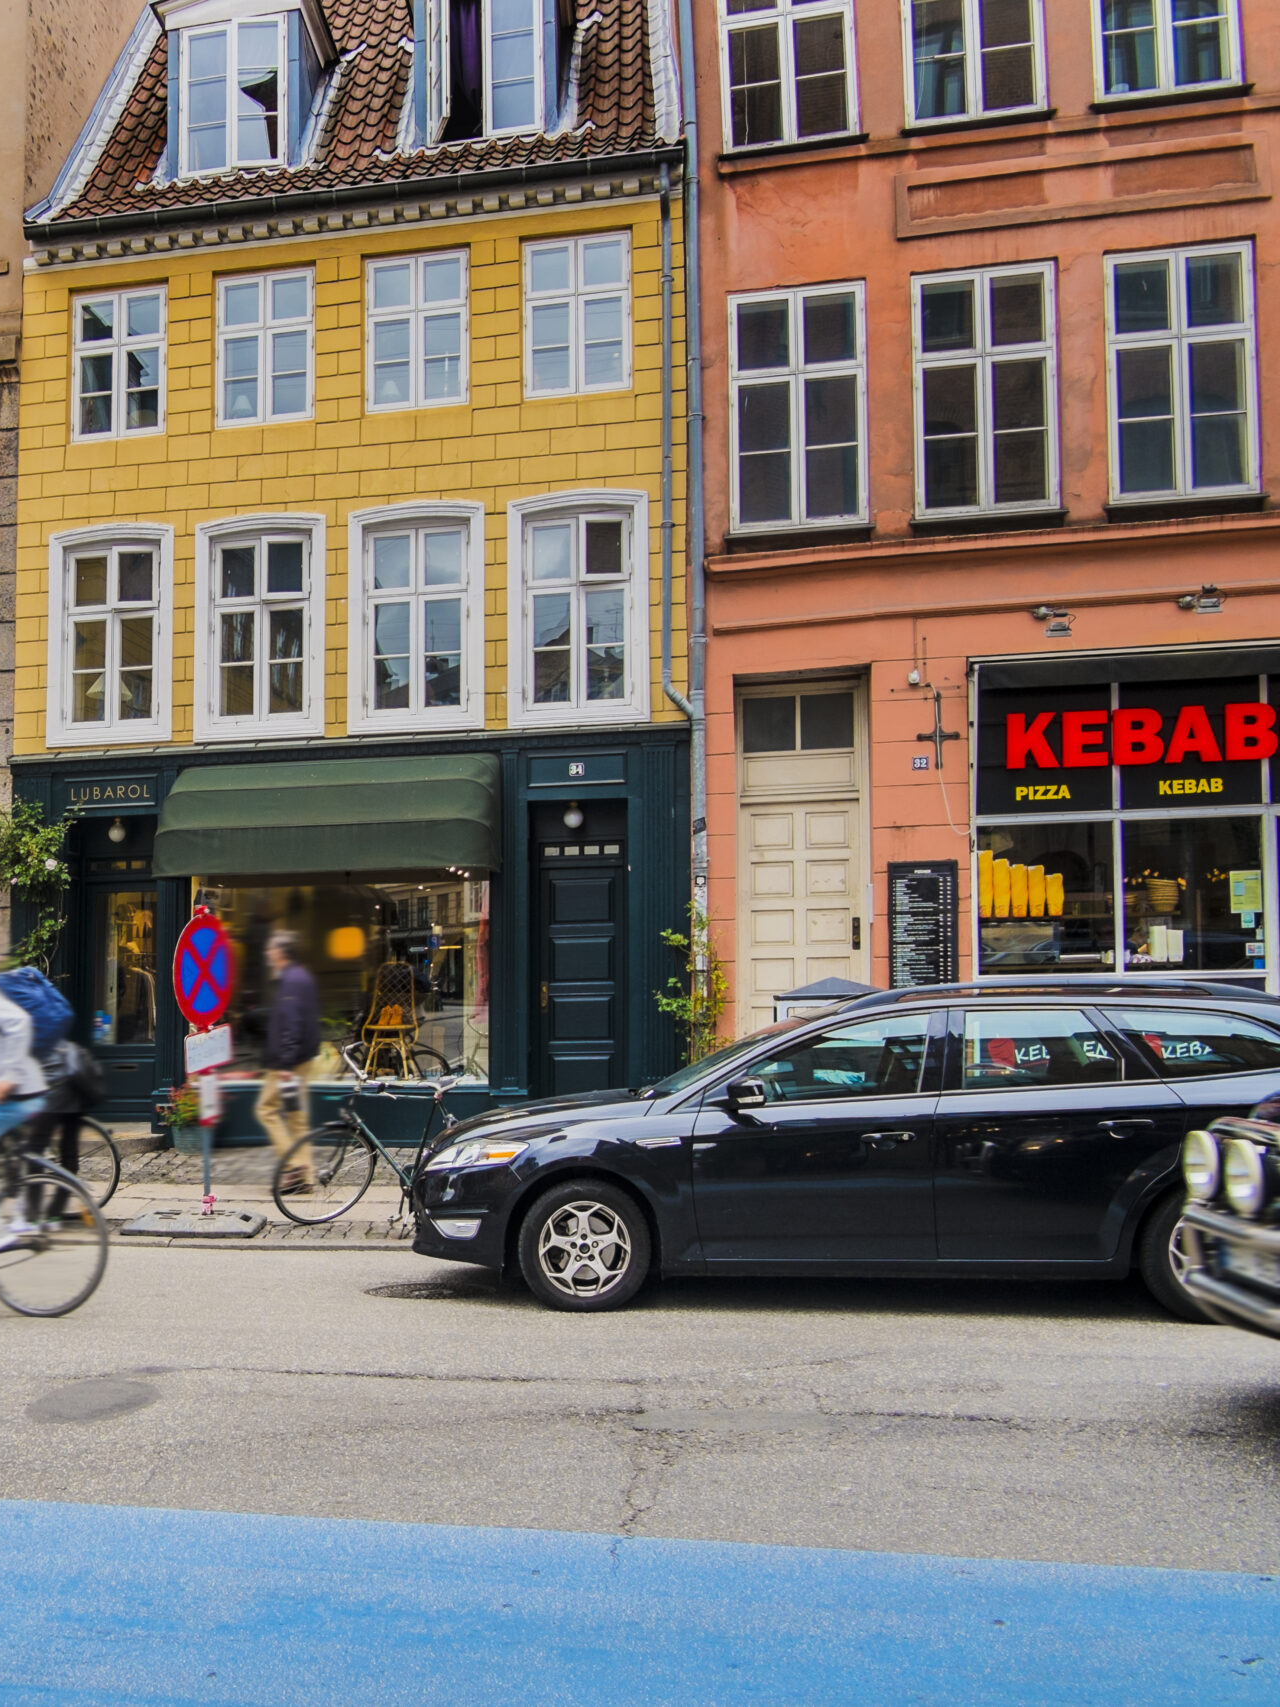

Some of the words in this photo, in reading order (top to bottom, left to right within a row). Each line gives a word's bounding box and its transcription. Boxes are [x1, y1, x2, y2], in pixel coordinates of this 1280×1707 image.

[1006, 702, 1279, 769] KEBAB
[914, 758, 927, 768] 32
[71, 784, 150, 801] LUBAROL
[1016, 784, 1071, 800] PIZZA
[1159, 778, 1224, 795] KEBAB
